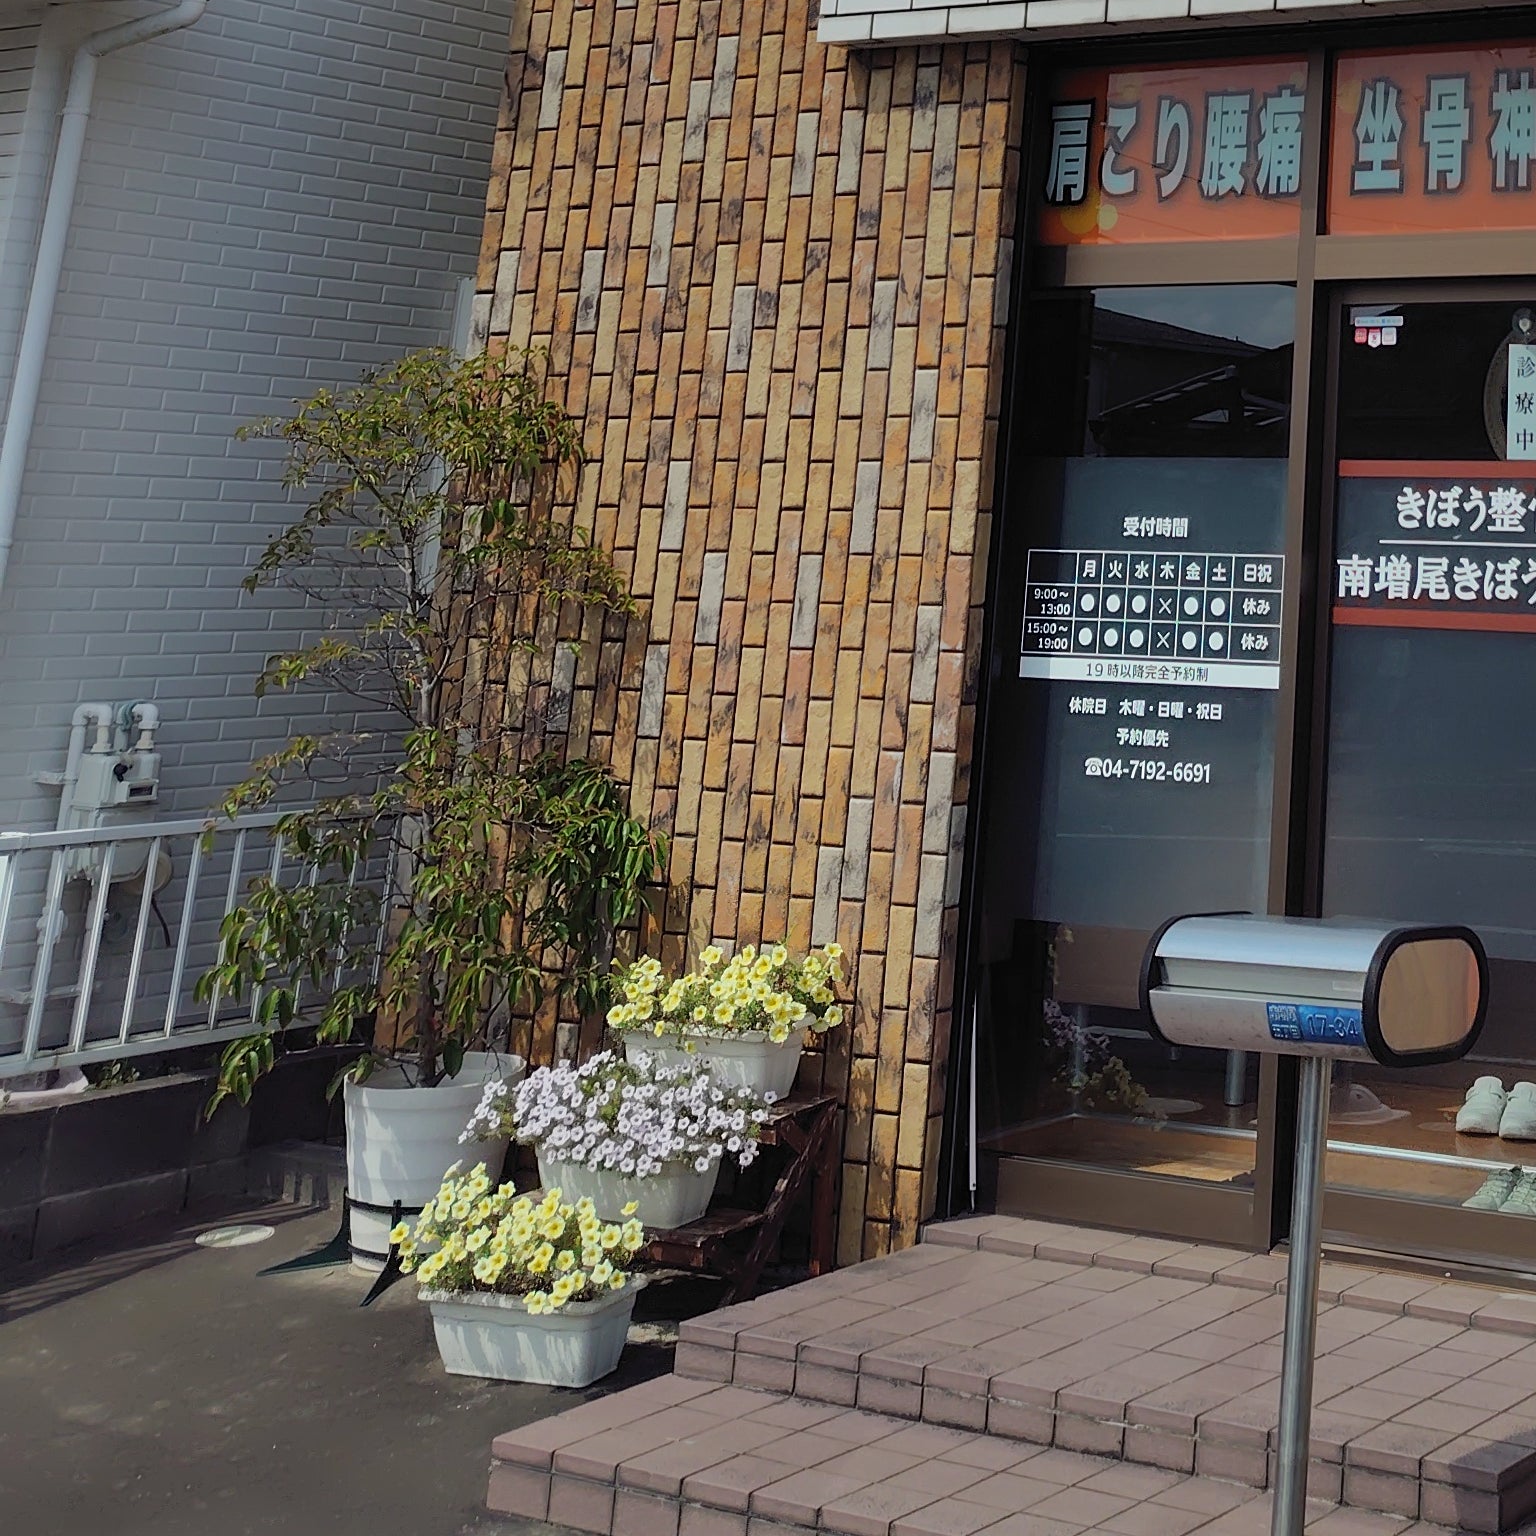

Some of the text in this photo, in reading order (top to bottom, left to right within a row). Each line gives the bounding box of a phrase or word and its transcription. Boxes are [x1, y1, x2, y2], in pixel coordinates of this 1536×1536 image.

[1044, 88, 1304, 204] 肩こり腰痛
[1515, 356, 1536, 452] 診療中
[1123, 517, 1189, 538] 受付時間
[1082, 560, 1272, 583] 月 火 水 木 金 土 日祝
[1040, 603, 1071, 615] 13:00
[1243, 598, 1271, 616] 休み
[1038, 638, 1068, 650] 19:00
[1241, 633, 1269, 651] 休み
[1069, 697, 1222, 720] 休院日 木曜・日曜・祝日
[1116, 729, 1169, 748] 予約優先
[1306, 1014, 1359, 1038] 17-34
